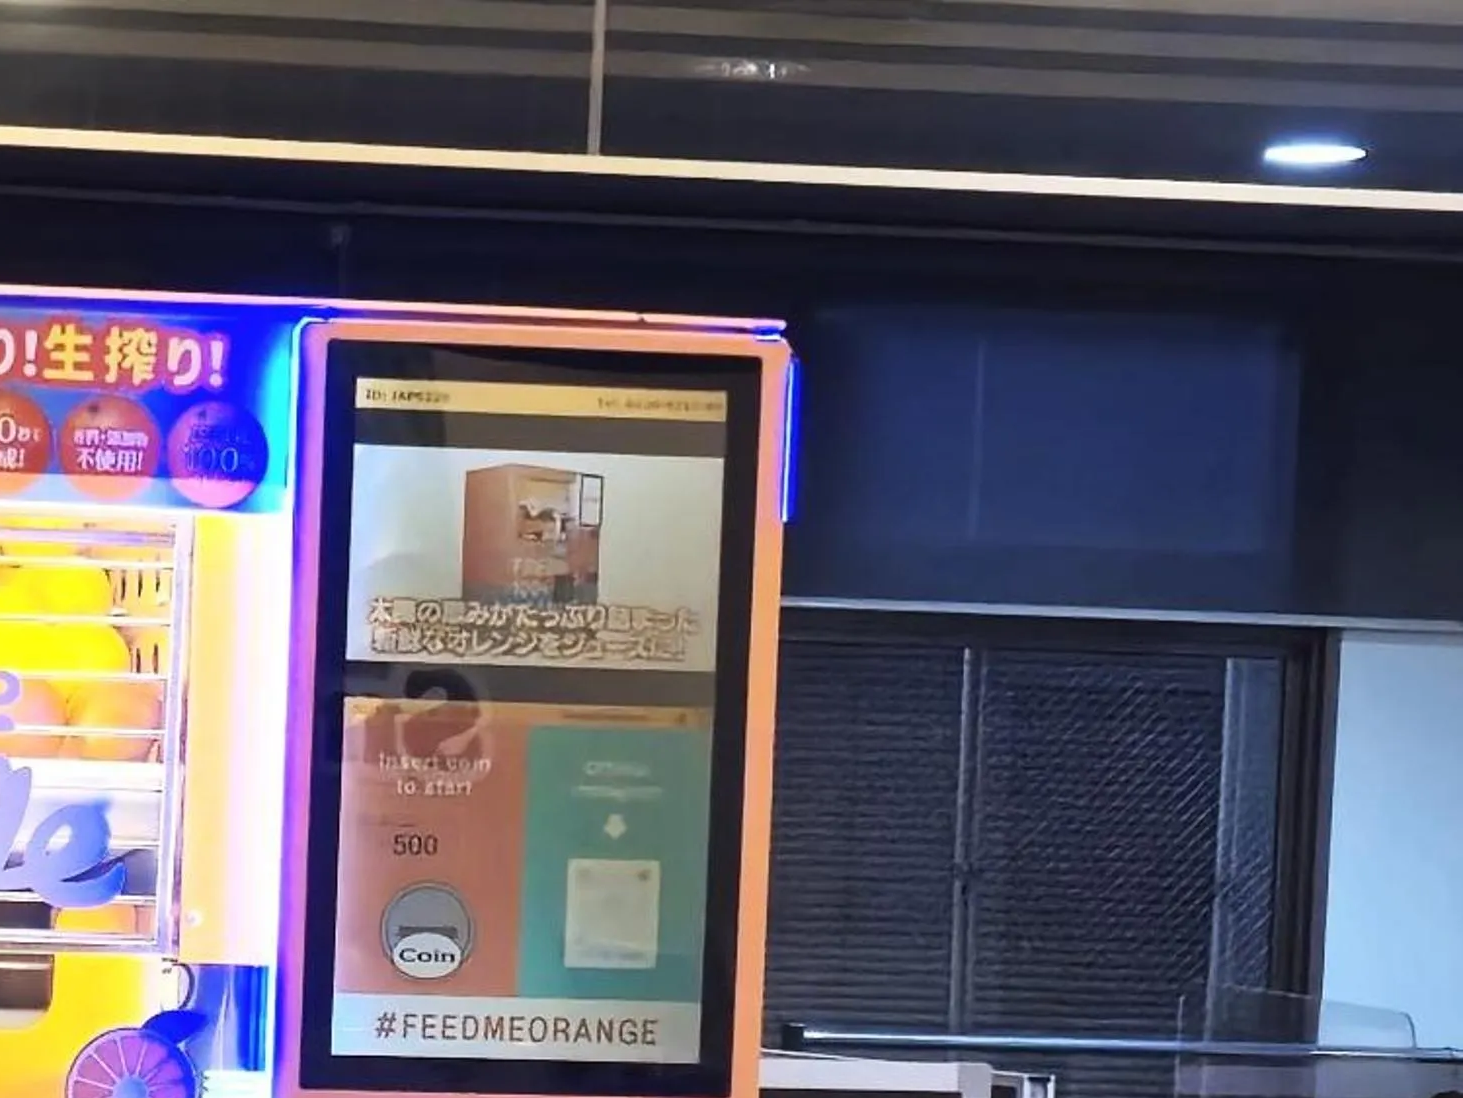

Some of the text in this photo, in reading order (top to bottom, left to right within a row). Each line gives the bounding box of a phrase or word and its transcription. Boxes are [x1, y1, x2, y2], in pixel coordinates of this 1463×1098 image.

[76, 448, 143, 473] 不使用!
[396, 778, 473, 796] to start
[393, 834, 438, 857] 500
[398, 946, 456, 964] Coin
[375, 1014, 659, 1046] #FEEDMEORANGE
